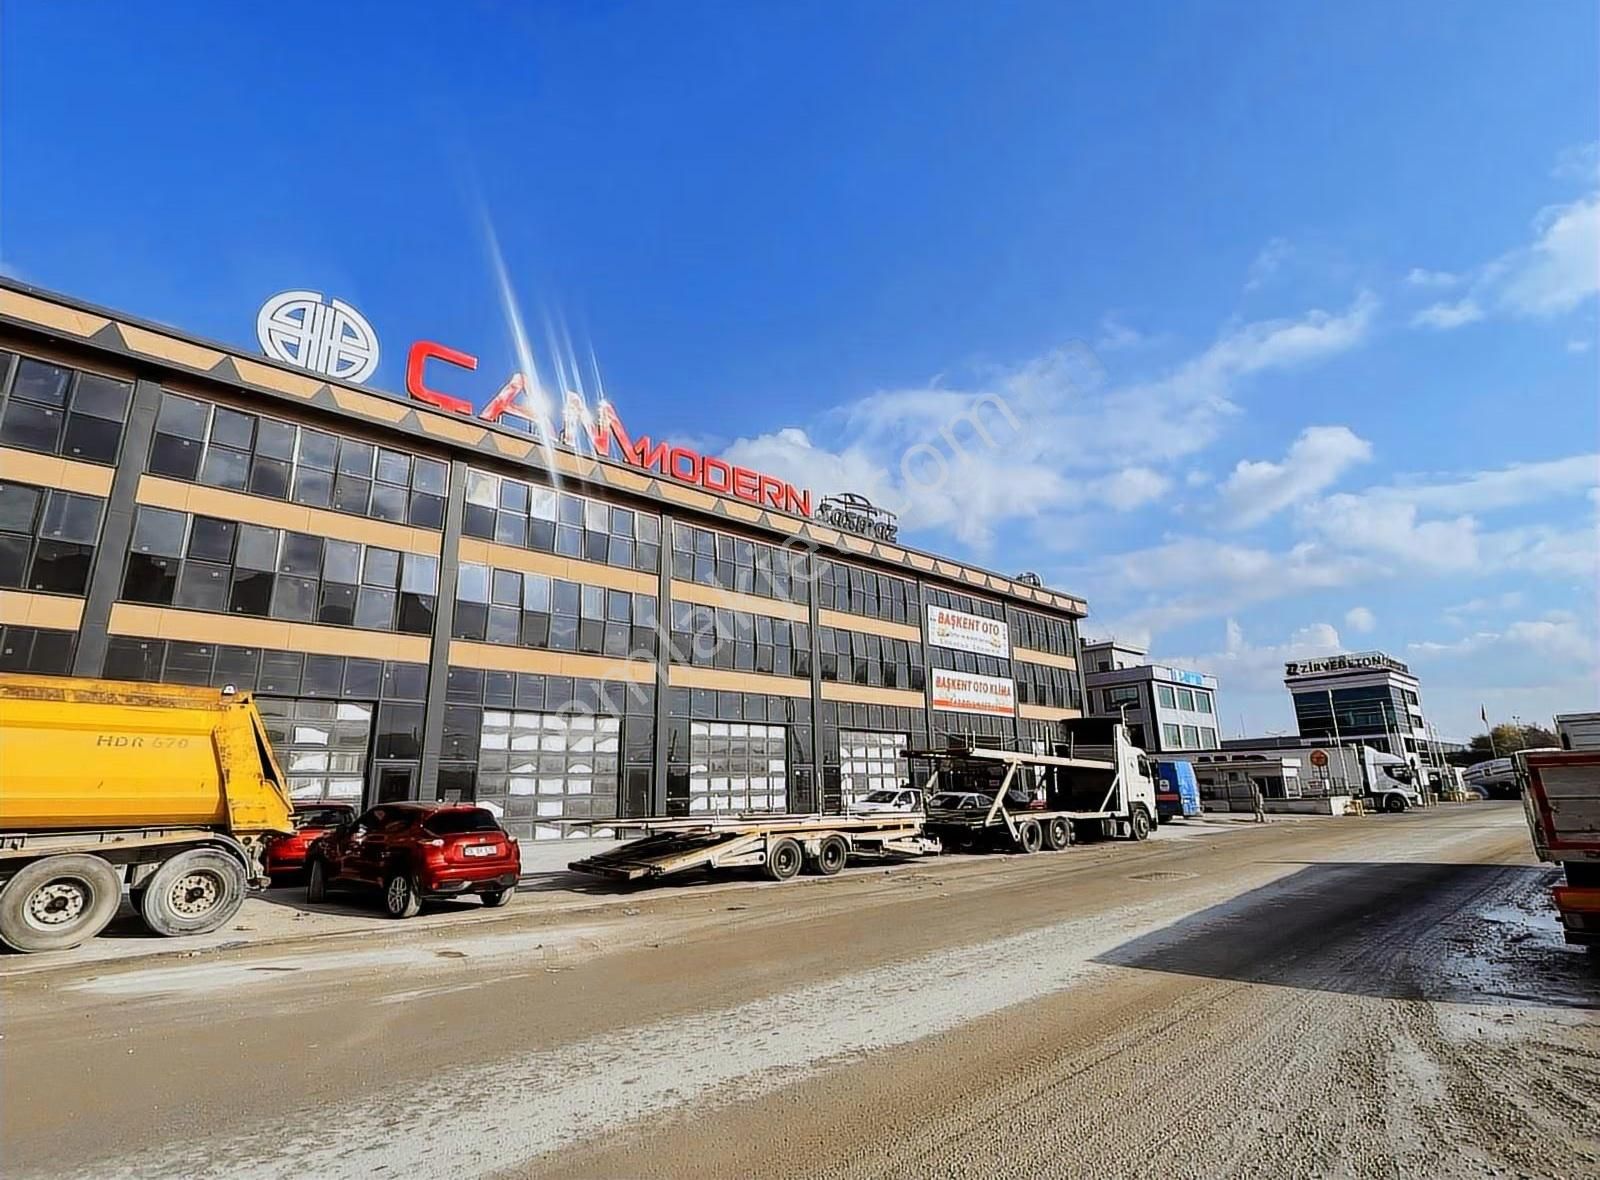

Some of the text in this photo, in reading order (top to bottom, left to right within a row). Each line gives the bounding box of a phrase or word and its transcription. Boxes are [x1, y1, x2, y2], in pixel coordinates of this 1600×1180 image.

[633, 437, 812, 517] MODERN
[937, 611, 1000, 635] BAŞKENT OTO
[935, 676, 971, 693] BAŞKENT
[973, 682, 988, 694] OTO
[97, 735, 144, 747] HDR
